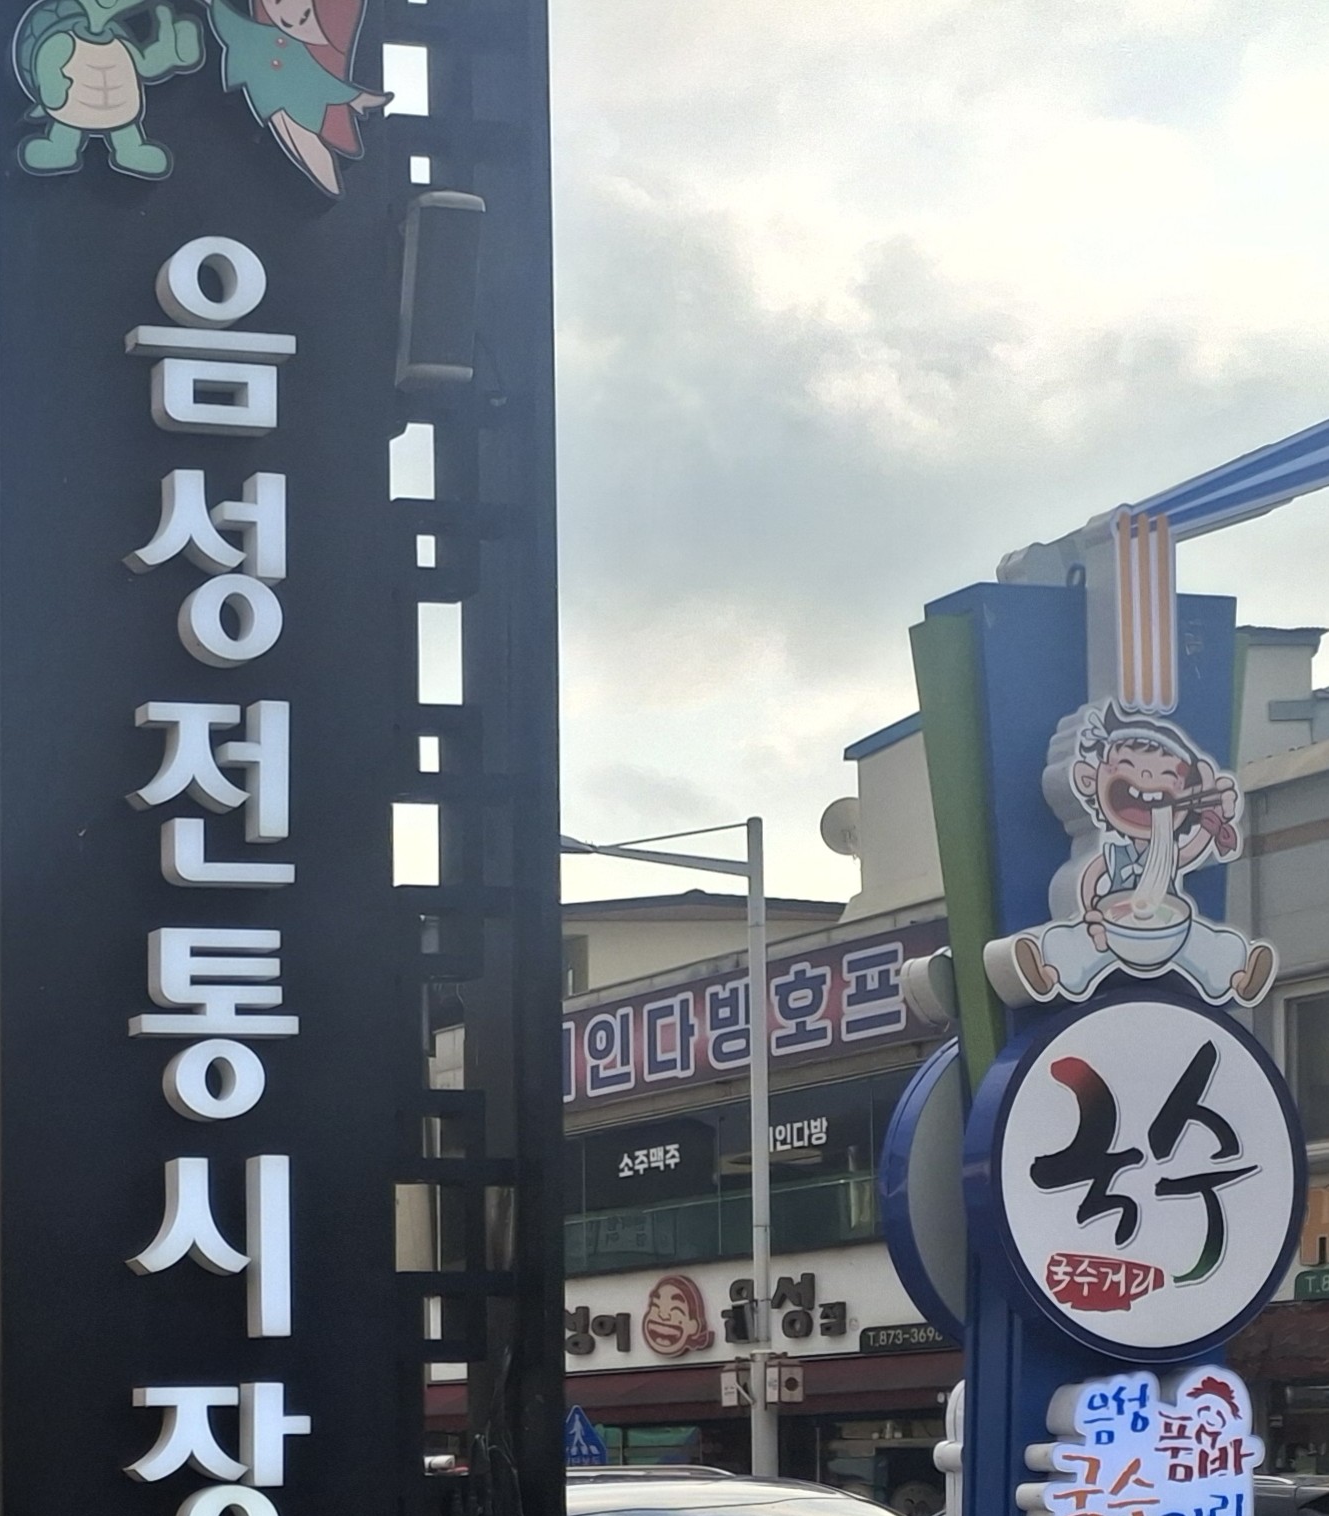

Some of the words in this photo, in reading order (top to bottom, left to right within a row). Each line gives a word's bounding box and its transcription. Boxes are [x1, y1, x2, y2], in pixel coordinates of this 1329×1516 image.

[563, 941, 906, 1102] 인다방호프
[618, 1143, 681, 1178] 소주맥주
[768, 1117, 828, 1152] 인다방
[1030, 1039, 1259, 1284] 국수
[1049, 1255, 1156, 1297] 국수거리
[1083, 1383, 1150, 1445] 음성
